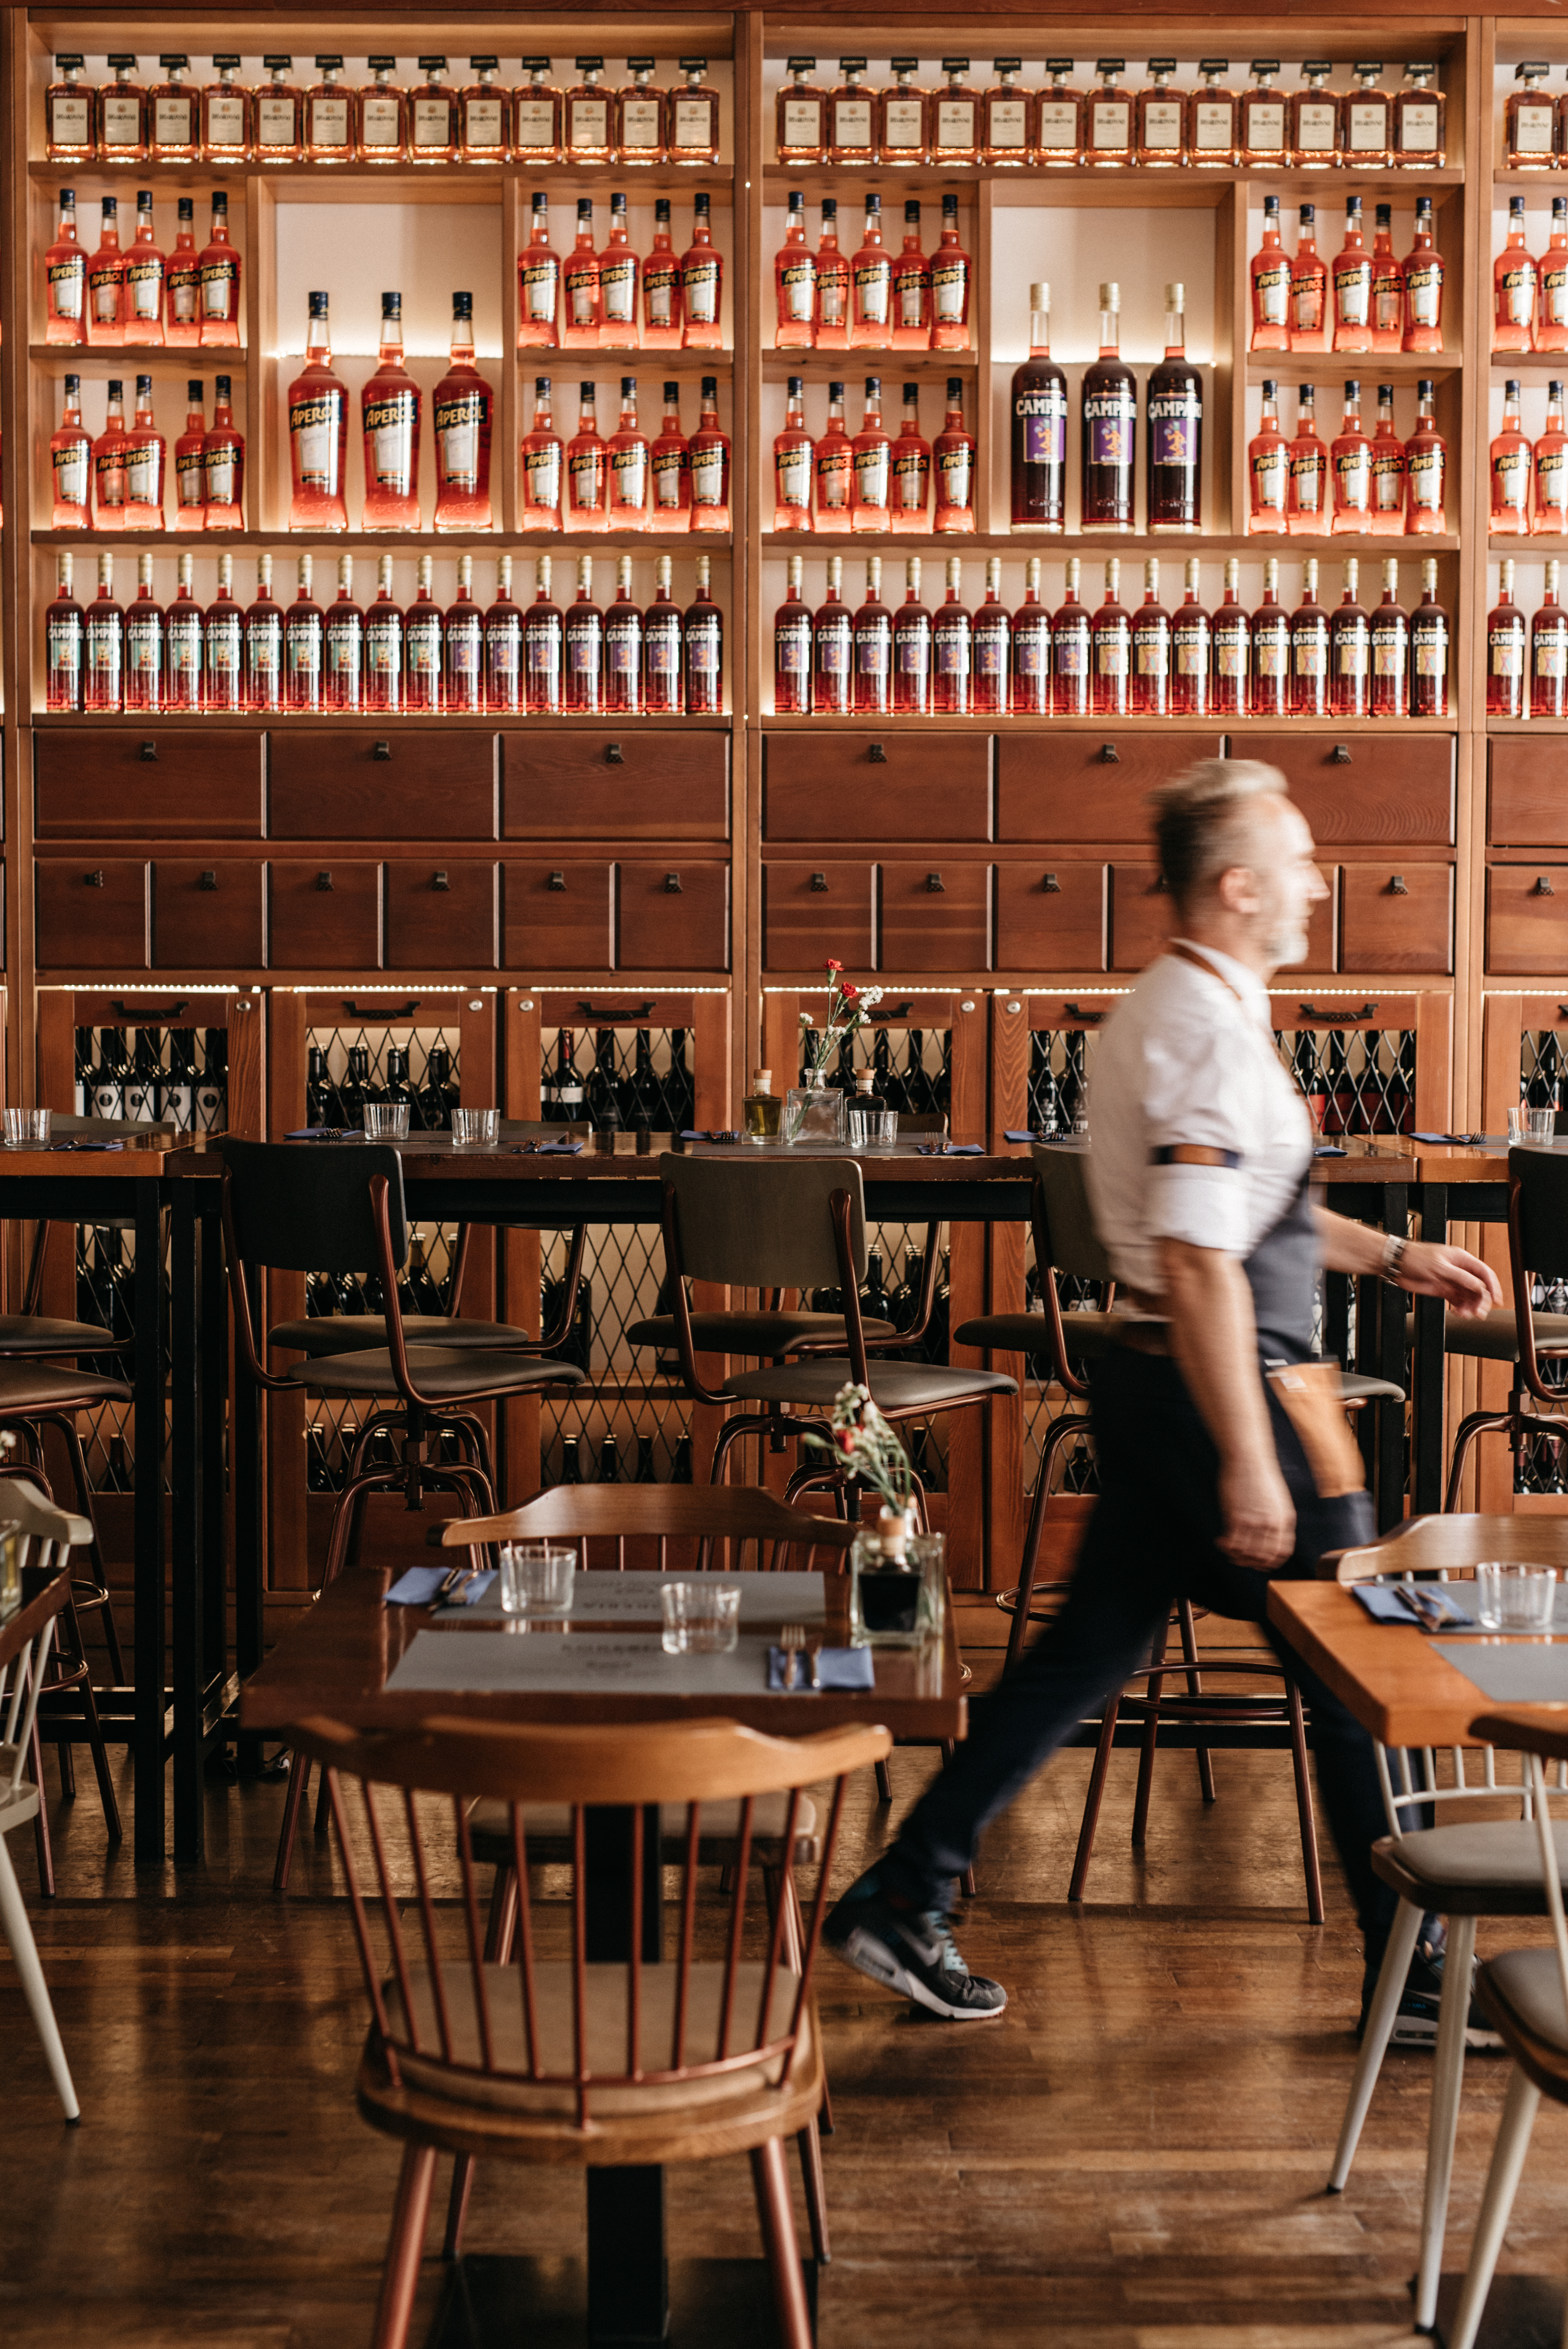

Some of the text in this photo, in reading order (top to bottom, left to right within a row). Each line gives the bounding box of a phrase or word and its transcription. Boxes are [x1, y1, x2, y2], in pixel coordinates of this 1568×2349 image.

[169, 273, 199, 286] APERO
[568, 275, 599, 288] APERO
[601, 268, 635, 282] APERO
[785, 268, 816, 282] APERL
[857, 268, 891, 282] APERL
[933, 268, 966, 282] APERO
[1258, 271, 1292, 285] APERL
[1336, 271, 1372, 286] APERL
[1409, 272, 1443, 286] APERL
[1507, 273, 1536, 287] APEOL
[1374, 279, 1402, 293] APERO
[1016, 399, 1067, 416] CAMPR
[1085, 401, 1136, 418] CAMPR
[291, 405, 341, 428] APERO
[55, 450, 89, 464] APERO
[98, 457, 125, 469] APERO
[126, 449, 154, 464] APERO
[177, 457, 203, 469] APERO
[527, 453, 561, 468] APERO
[614, 453, 647, 467] APERL
[692, 453, 724, 466] APERO
[779, 453, 813, 467] APERO
[855, 453, 890, 467] APERO
[942, 454, 973, 468] APEO
[1256, 456, 1289, 469] APERL
[1340, 455, 1373, 469] APERL
[1411, 455, 1445, 469] APERL
[1499, 456, 1532, 469] APEL
[820, 458, 852, 471] APERO
[896, 458, 928, 472] APEOL
[1540, 456, 1565, 471] APER
[49, 628, 84, 640] CAMPRI
[87, 628, 123, 640] CAMPRI
[128, 628, 164, 640] CAMPRI
[168, 628, 203, 640] CAMPRI
[207, 628, 242, 641] CAMPRI
[247, 628, 283, 641] CAMPRI
[247, 629, 282, 641] CAMPRI
[287, 629, 323, 641] CAMPRI
[328, 629, 363, 641] CAMPRI
[367, 629, 402, 641] CAMPRI
[407, 630, 443, 641] CAMPRI
[447, 630, 483, 642] CAMPRI
[487, 630, 522, 642] CAMPRI
[526, 630, 561, 642] CAMPRI
[567, 630, 603, 642] CAMPRI
[607, 630, 643, 642] CAMPRI
[646, 631, 682, 642] CAMPRI
[686, 631, 721, 642] CAMPRI
[776, 630, 812, 642] CAMPRI
[818, 630, 853, 642] CAMPRI
[857, 631, 892, 643] CAMPRI
[897, 631, 931, 643] CAMPRI
[936, 632, 971, 644] CAMPRI
[975, 632, 1011, 644] AMPRI
[1016, 633, 1051, 645] CAMPRI
[1055, 633, 1091, 645] CAMPRI
[1095, 633, 1131, 646] CAMPRI
[1135, 633, 1170, 646] CAMPRI
[1175, 633, 1210, 646] CAMPRI
[1214, 633, 1250, 646] CAMPRI
[1255, 633, 1289, 645] CAMPRI
[1293, 633, 1329, 645] CAMPRI
[1335, 633, 1369, 645] CAMPRI
[1372, 633, 1408, 646] CAMPRI
[1413, 633, 1448, 646] CAMPRI
[1490, 633, 1525, 646] CAMPRI
[1534, 634, 1568, 647] CAMPR
